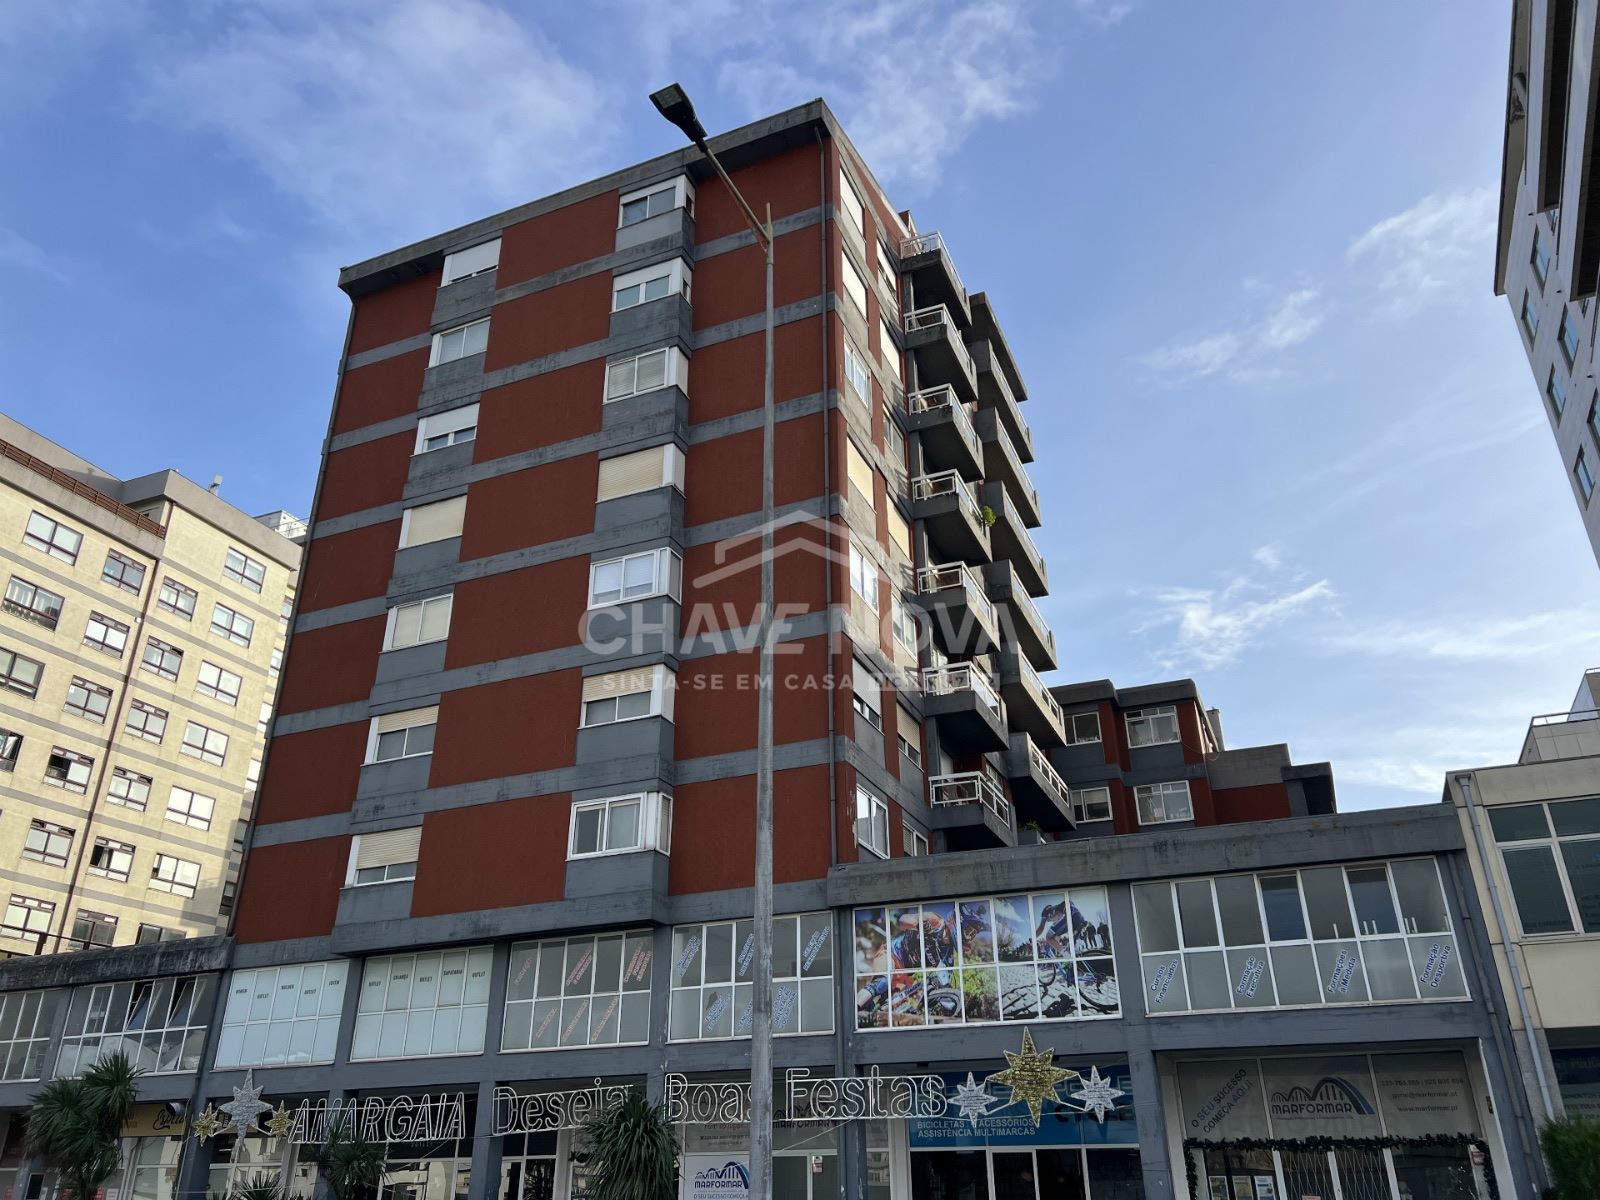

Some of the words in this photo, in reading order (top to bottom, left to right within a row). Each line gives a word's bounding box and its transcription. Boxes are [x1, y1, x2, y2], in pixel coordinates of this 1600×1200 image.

[1150, 964, 1167, 992] Cursos
[1154, 958, 1178, 1005] Financiados
[1236, 955, 1256, 995] Formação
[1246, 960, 1264, 998] Executiva
[1327, 949, 1348, 994] Formações
[1341, 957, 1356, 988] Medida
[1419, 943, 1440, 984] Formação
[1430, 945, 1451, 989] Desportiva
[288, 1091, 466, 1144] AMARGAIA
[663, 1072, 752, 1124] Boa
[786, 1066, 948, 1121] Festas
[1198, 1102, 1215, 1120] SEU
[1213, 1068, 1247, 1106] SUCESSO
[1203, 1103, 1235, 1133] COMEÇA
[1231, 1081, 1253, 1105] AQUI
[1271, 1102, 1352, 1115] MARFORMAR
[772, 1119, 830, 1129] MARFORMAR
[917, 1121, 965, 1129] BICICLETAS
[978, 1118, 1034, 1127] ACESSÓRIOS
[917, 1128, 972, 1138] ASSISTÊNCIA
[974, 1127, 1036, 1137] MULTIMARCAS
[694, 1180, 743, 1189] MARFORMAR
